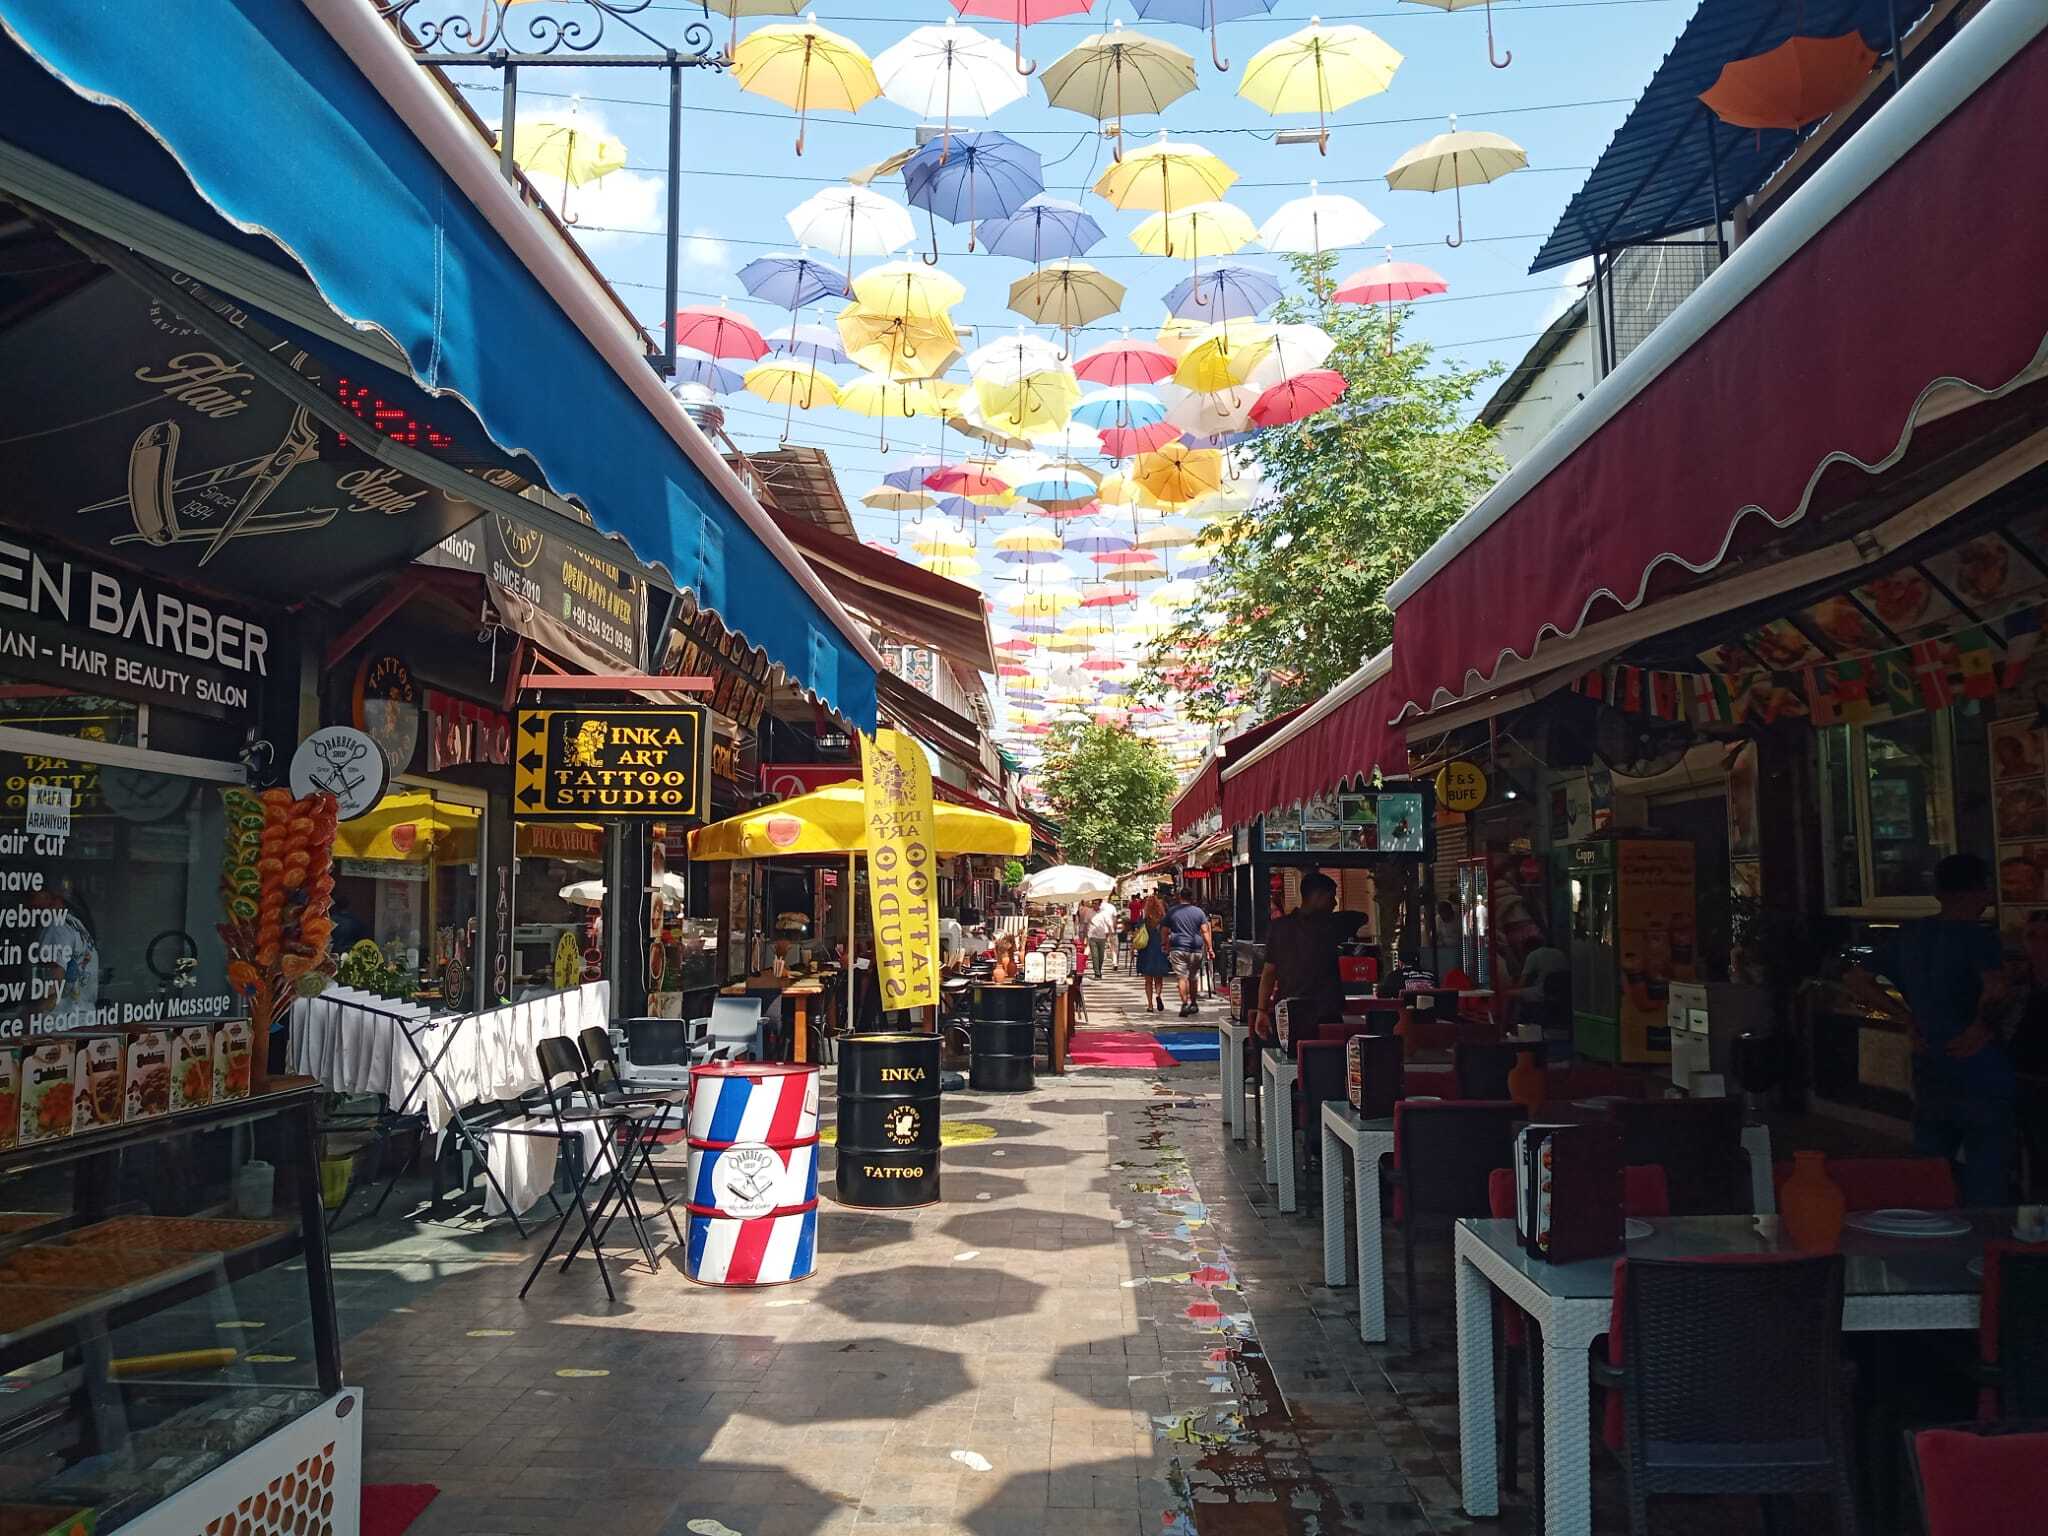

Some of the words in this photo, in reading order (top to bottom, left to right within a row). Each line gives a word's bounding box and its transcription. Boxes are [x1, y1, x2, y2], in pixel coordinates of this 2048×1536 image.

[135, 352, 255, 418] Hair
[200, 485, 237, 508] Since
[179, 498, 216, 521] 1994
[562, 560, 582, 595] OPEN
[521, 577, 541, 604] 2010
[89, 571, 269, 677] BARBER
[572, 606, 586, 628] +90
[587, 612, 600, 637] 534
[601, 621, 614, 645] 923
[623, 635, 632, 656] 99
[60, 643, 108, 677] HAIR
[115, 656, 191, 696] BEAUTY
[196, 678, 248, 710] SALON
[610, 727, 685, 749] INKA
[617, 750, 668, 768] ART
[554, 770, 686, 787] TATTOO
[557, 789, 684, 805] STUDIO
[34, 834, 66, 856] Cut
[28, 941, 73, 964] Care
[31, 977, 66, 1005] Dry
[30, 1010, 79, 1035] Head
[84, 1003, 119, 1025] and
[124, 1001, 165, 1023] Body
[168, 994, 231, 1018] Massage
[880, 1066, 926, 1082] INKA
[886, 1104, 921, 1121] TATTOO
[886, 1131, 920, 1145] STUDIO
[863, 1166, 924, 1179] TATTOO
